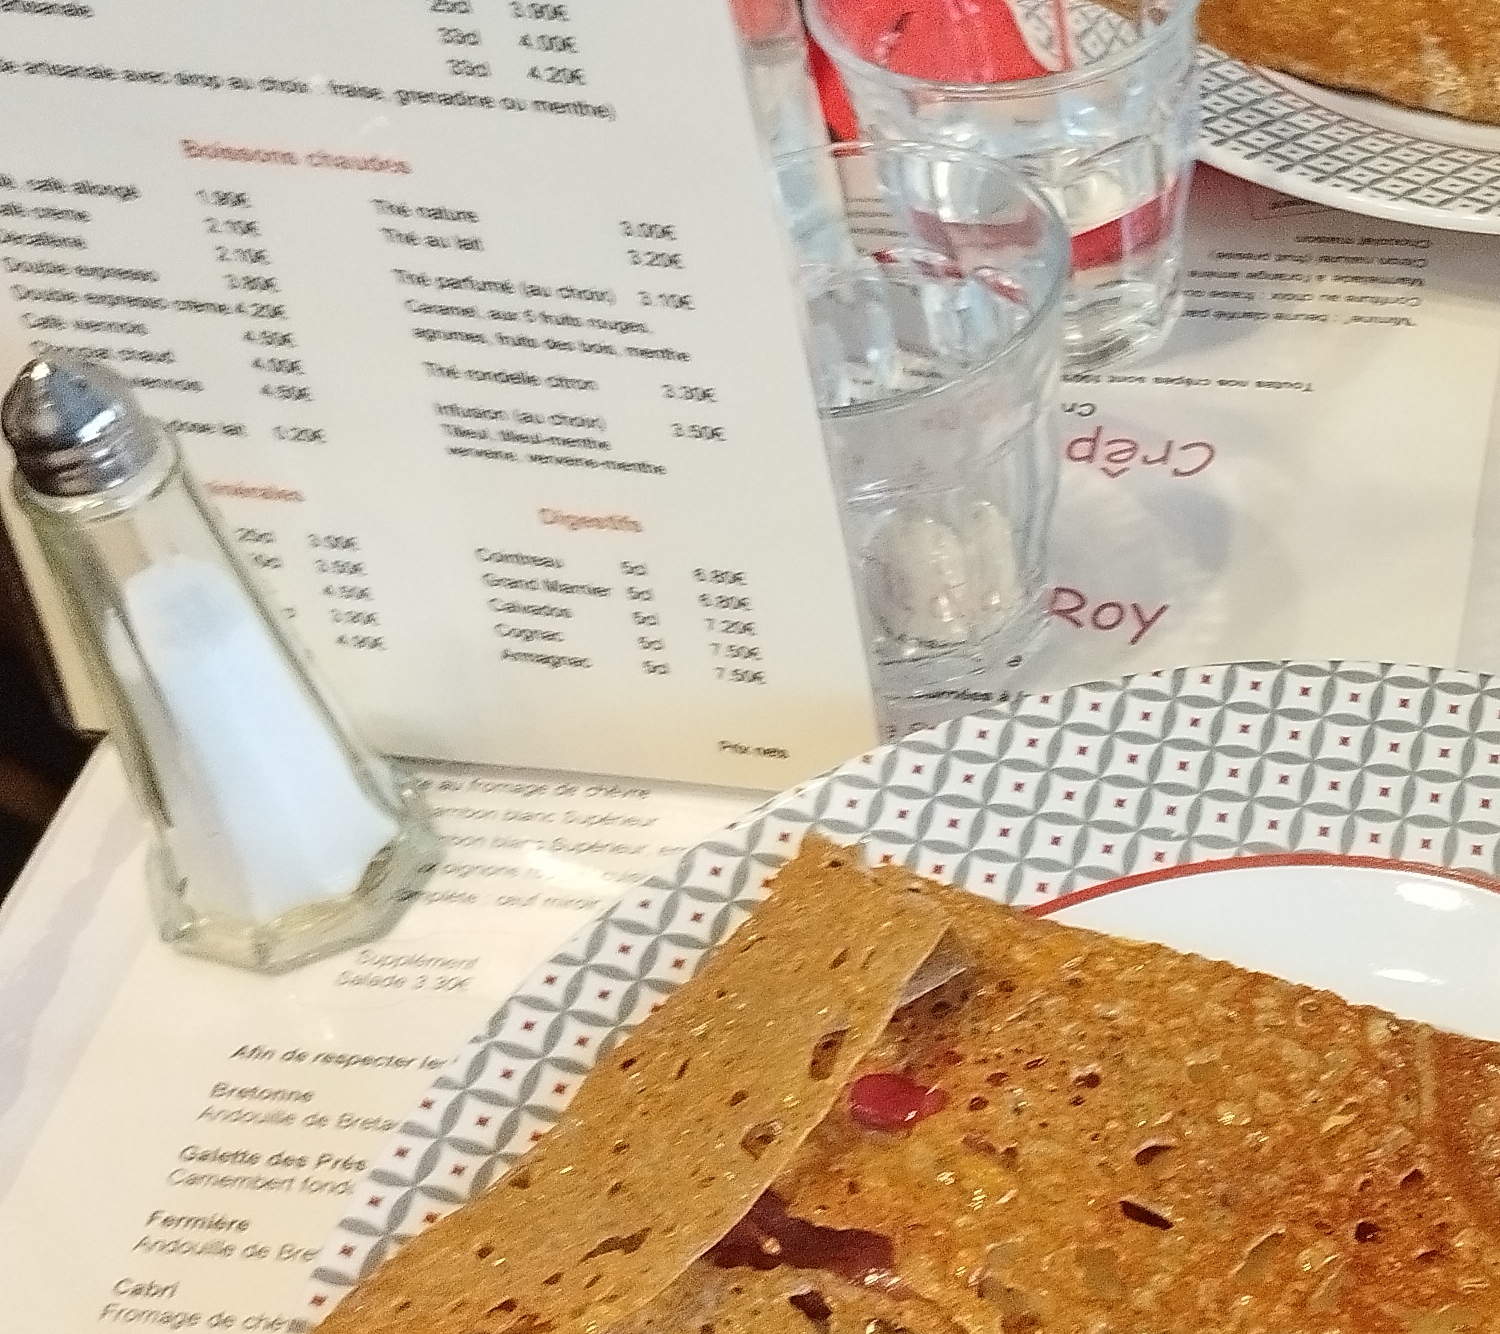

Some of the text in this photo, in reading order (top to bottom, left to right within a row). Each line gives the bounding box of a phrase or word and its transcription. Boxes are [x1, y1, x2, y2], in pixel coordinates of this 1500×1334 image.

[179, 138, 414, 175] Boissons chaudes
[370, 198, 412, 218] Thé
[414, 204, 480, 224] nature
[379, 227, 420, 246] Thé
[391, 268, 432, 288] Thé
[422, 360, 461, 380] Thé
[1255, 378, 1315, 393] Toutes
[1064, 424, 1218, 479] Crêp
[538, 506, 645, 534] Digestifs
[475, 546, 565, 570] Cointreau
[1047, 585, 1168, 645] Roy
[467, 776, 549, 800] fromage
[552, 781, 579, 798] de
[502, 806, 660, 830] blanc Supérieur
[356, 946, 480, 971] Supplément
[334, 969, 406, 989] Salade
[229, 1043, 418, 1070] Afin de respecter
[209, 1080, 316, 1105] Bretonne
[197, 1104, 330, 1129] Andouille de
[178, 1143, 368, 1172] Galette des Prés
[166, 1167, 297, 1193] Camembert
[145, 1209, 251, 1234] Fermière
[132, 1235, 270, 1260] Andouille de
[112, 1276, 181, 1299] Cabri
[99, 1302, 236, 1331] Fromage de
